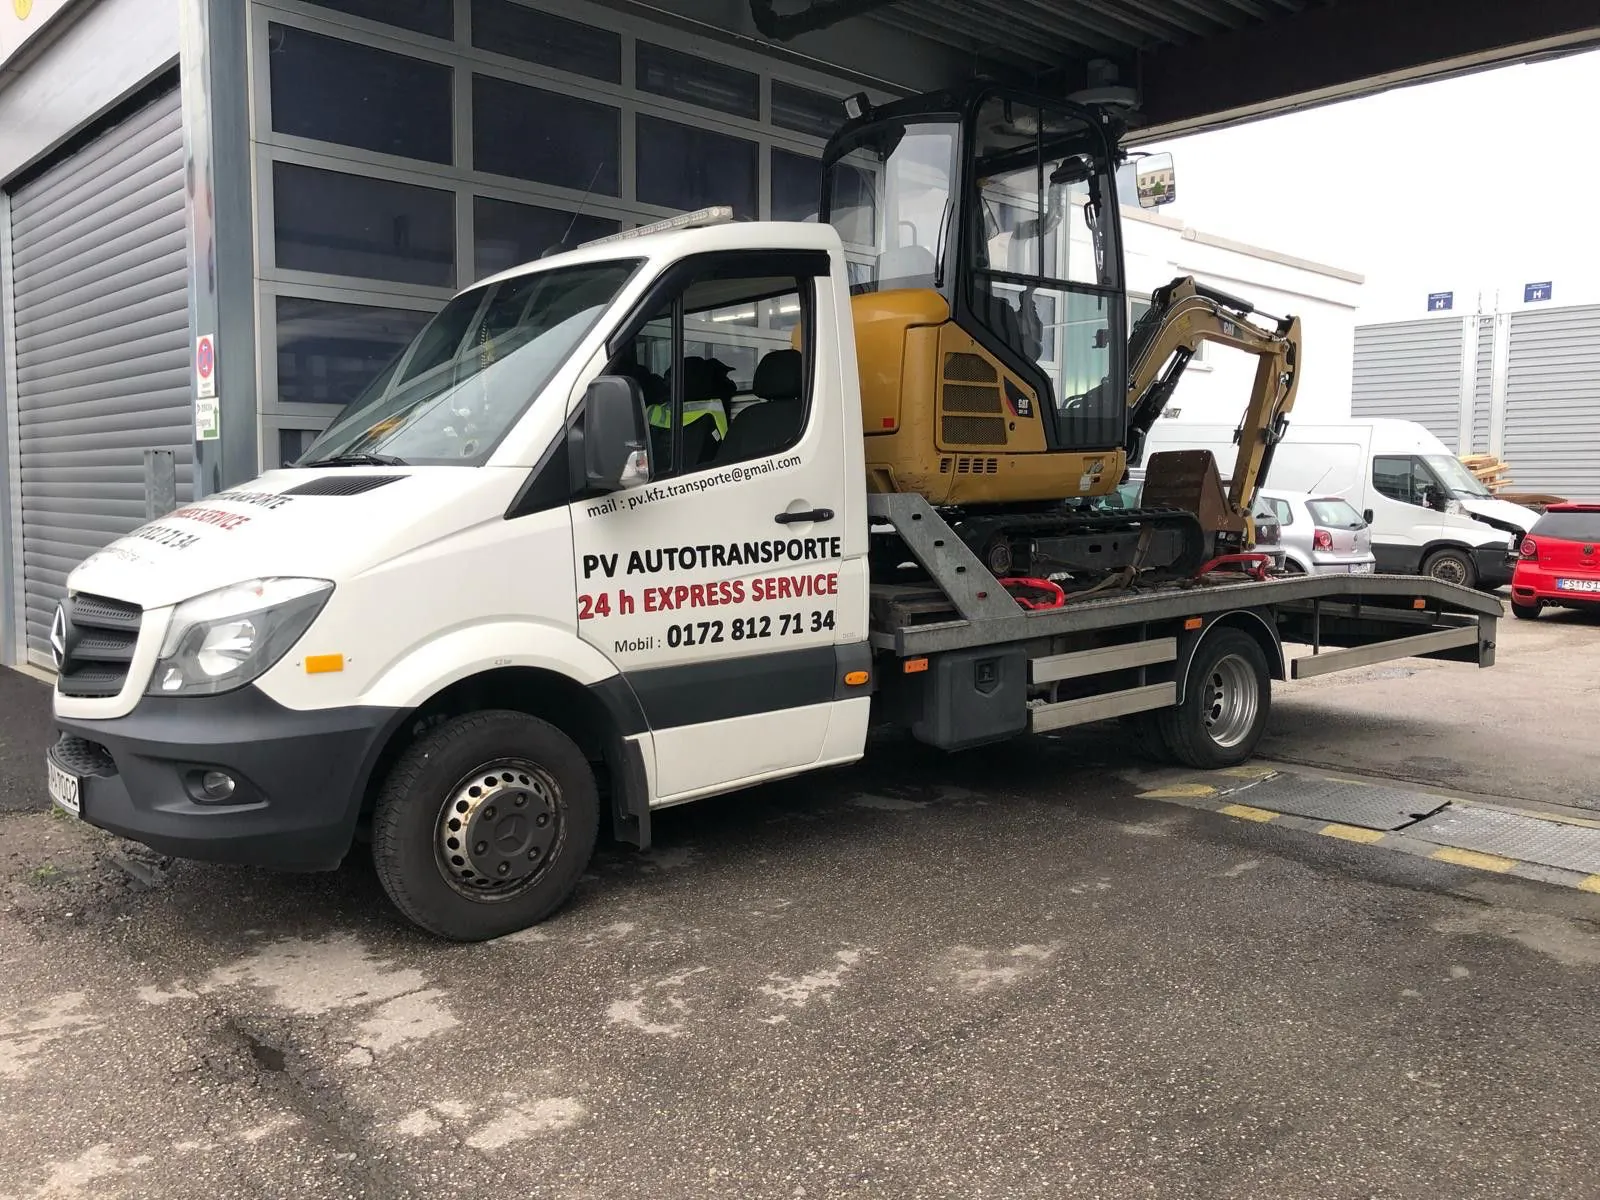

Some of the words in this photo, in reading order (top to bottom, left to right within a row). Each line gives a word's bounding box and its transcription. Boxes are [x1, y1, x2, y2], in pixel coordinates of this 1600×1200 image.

[586, 498, 618, 518] mail
[627, 454, 801, 511] pv.kfz.transporte@gmail.com
[582, 553, 618, 579] PV
[627, 537, 841, 575] AUTOTRANSPORTE
[578, 593, 611, 620] 24
[620, 589, 635, 615] h
[643, 579, 746, 613] EXPRESS
[751, 573, 838, 602] SERVICE
[614, 636, 653, 654] Mobil
[667, 620, 724, 648] 0172
[731, 615, 771, 640] 812
[779, 613, 803, 636] 71
[810, 610, 835, 632] 34
